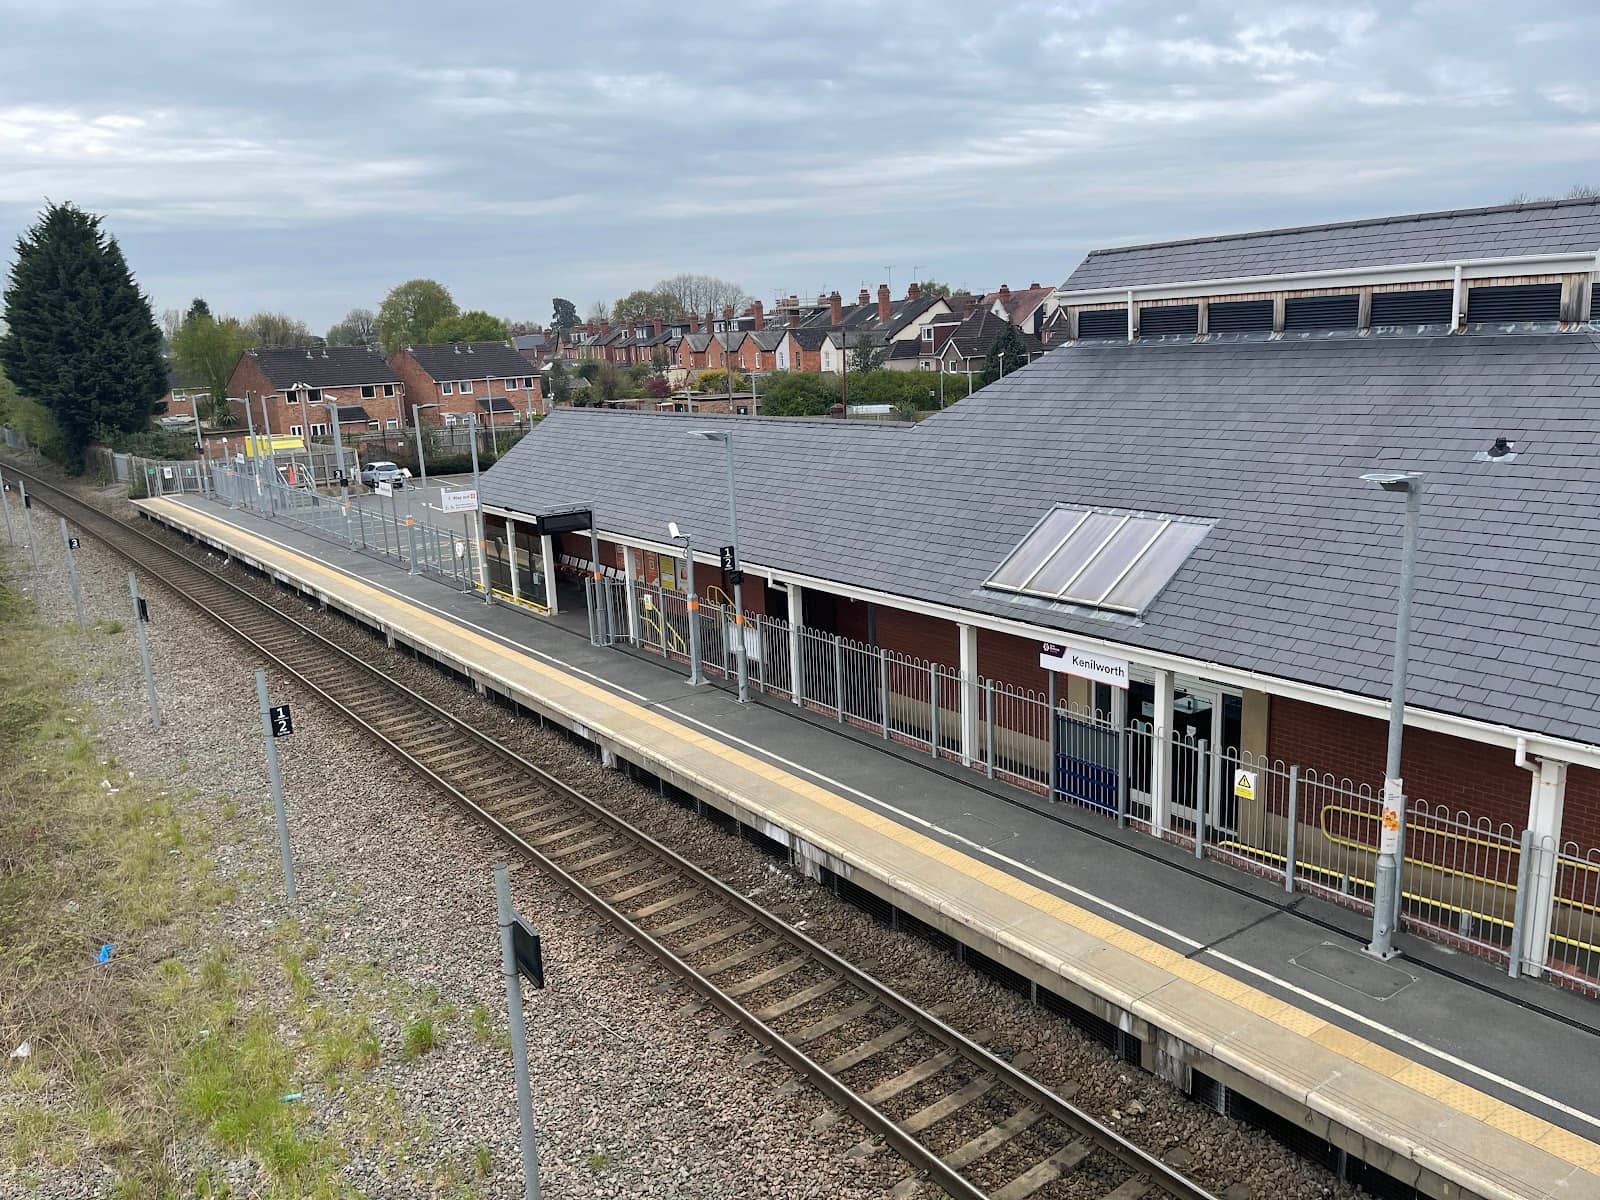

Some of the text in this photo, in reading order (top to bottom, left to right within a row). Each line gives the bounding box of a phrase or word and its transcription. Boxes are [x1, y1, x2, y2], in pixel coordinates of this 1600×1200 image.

[71, 539, 78, 547] 3
[724, 547, 731, 557] 1
[725, 558, 732, 568] 2
[1072, 655, 1125, 678] Kenilworth
[276, 707, 286, 719] 1
[278, 720, 288, 732] 2
